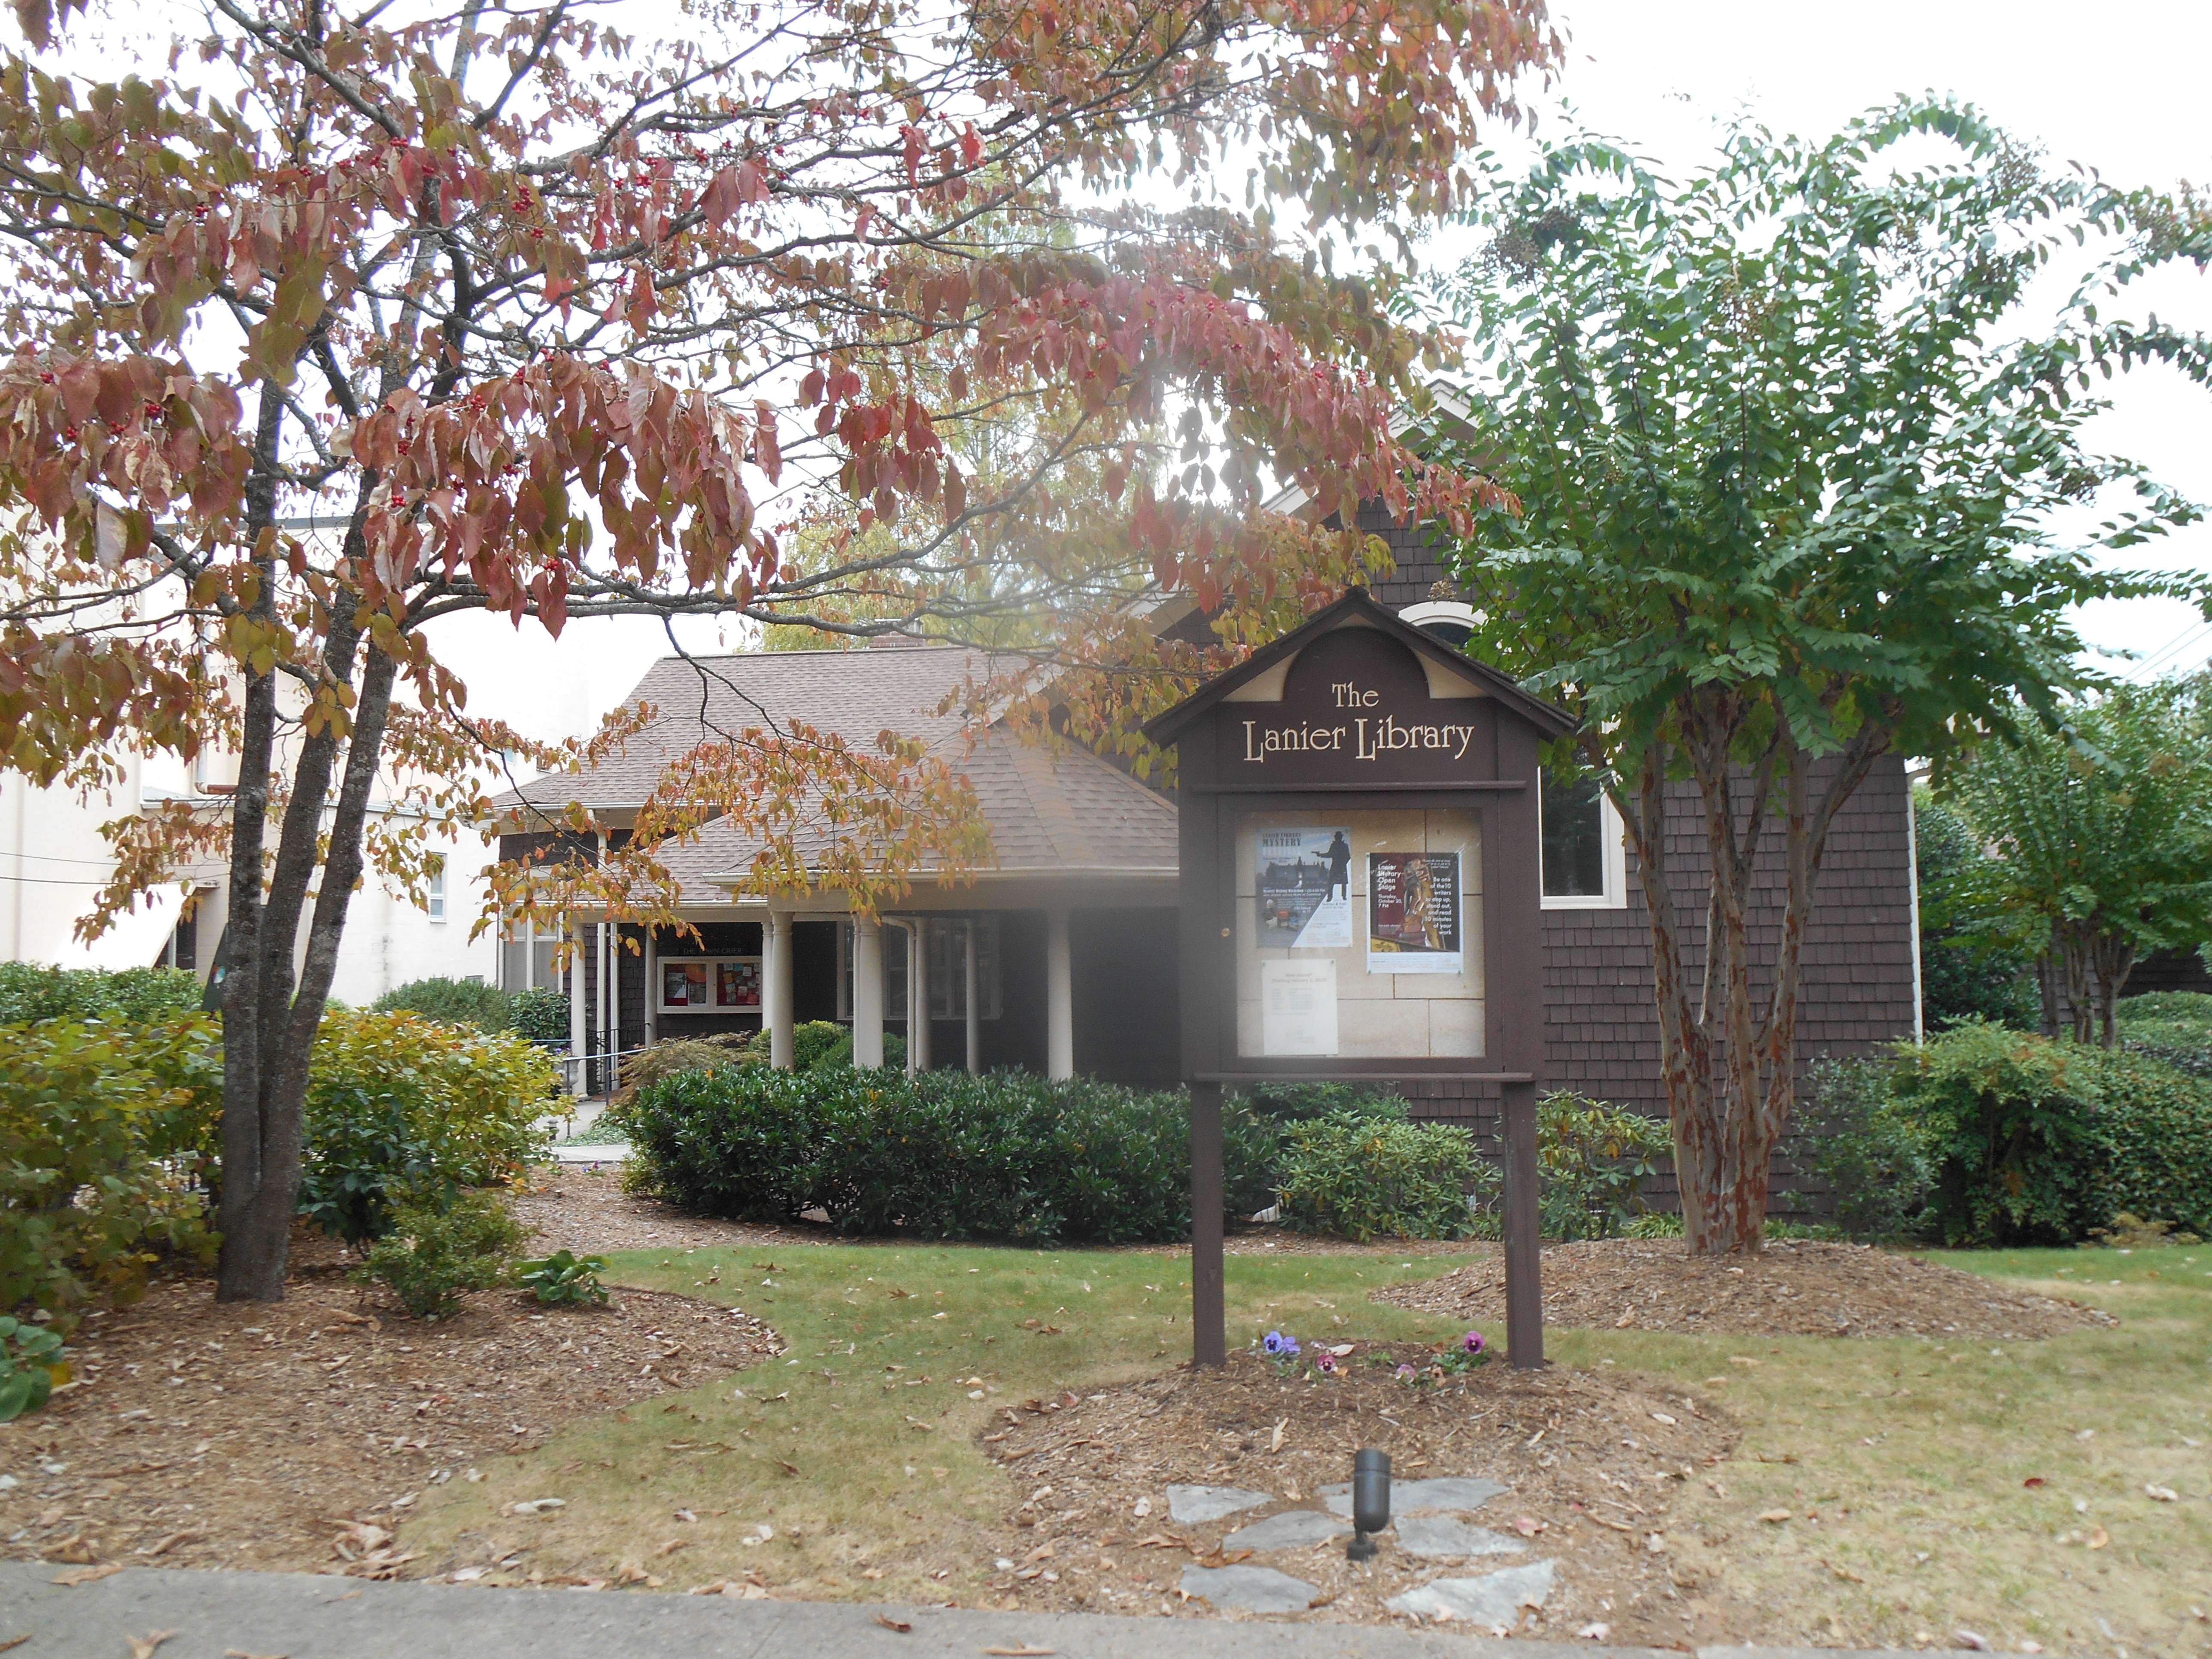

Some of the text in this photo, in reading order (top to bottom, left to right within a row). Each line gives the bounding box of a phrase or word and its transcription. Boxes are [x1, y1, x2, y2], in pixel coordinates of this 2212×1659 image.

[1332, 681, 1379, 707] The
[1243, 715, 1474, 763] Lanier Library
[1263, 838, 1301, 847] MYSTERY
